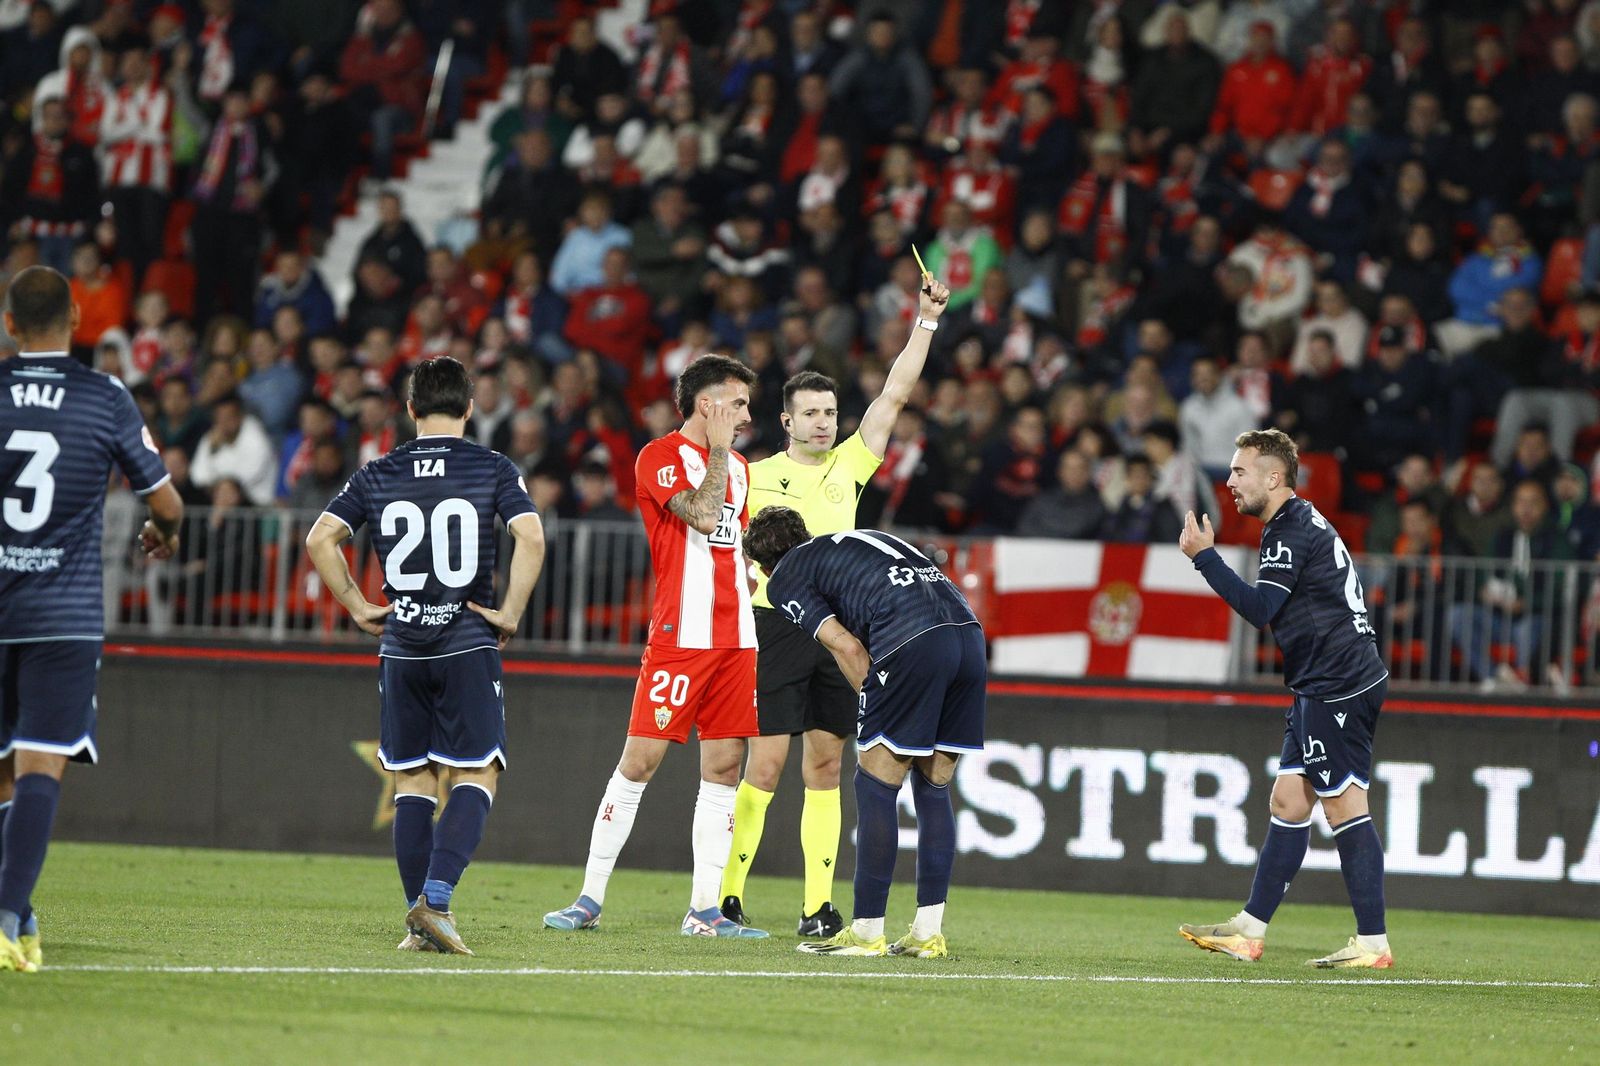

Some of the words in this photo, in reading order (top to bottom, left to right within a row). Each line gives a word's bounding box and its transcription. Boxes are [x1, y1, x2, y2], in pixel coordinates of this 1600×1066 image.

[10, 383, 66, 410] FALI
[4, 430, 61, 533] 3
[413, 459, 445, 477] IZA
[381, 498, 479, 591] 20
[649, 670, 690, 706] 20
